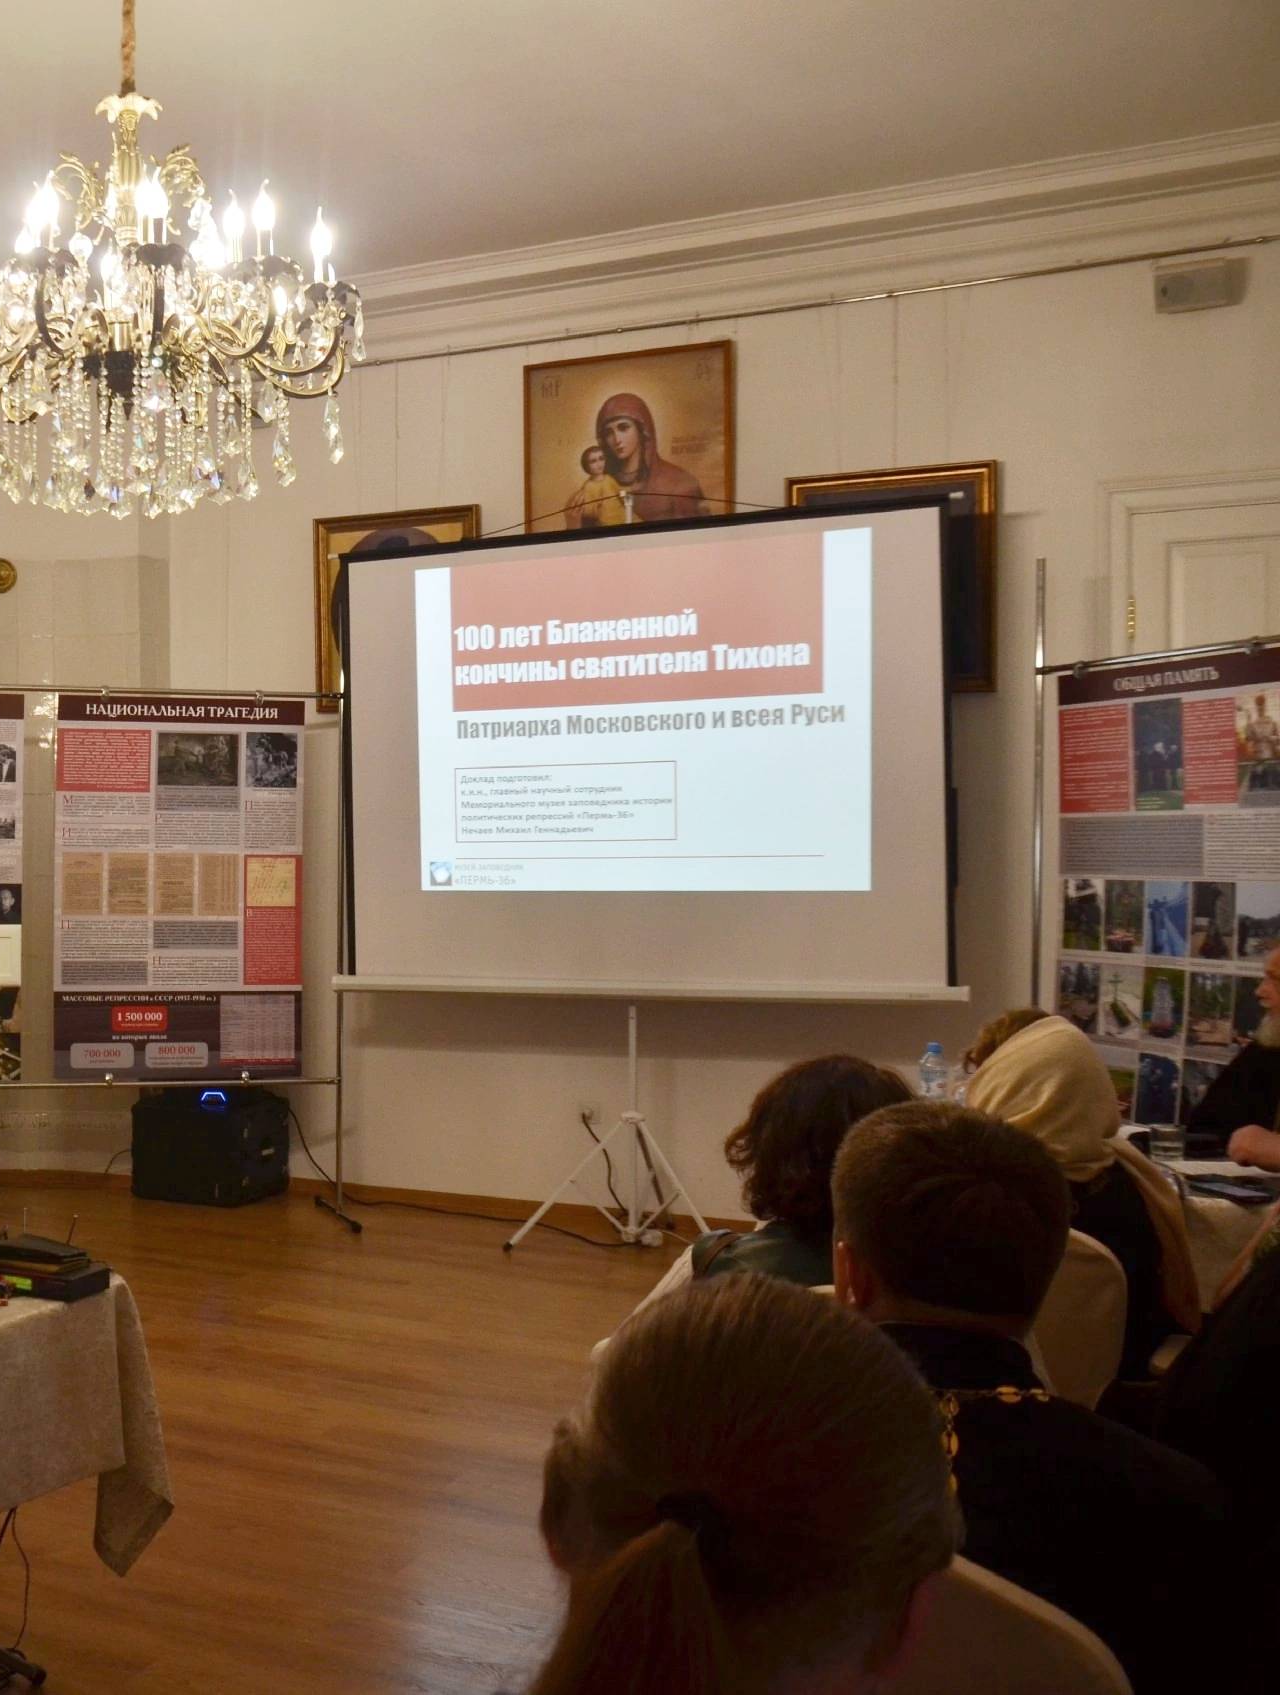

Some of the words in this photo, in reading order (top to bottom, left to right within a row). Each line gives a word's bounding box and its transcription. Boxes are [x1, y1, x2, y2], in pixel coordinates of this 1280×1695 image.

[454, 624, 495, 651] 100
[499, 625, 543, 648] лет
[547, 608, 698, 645] Блаженной
[455, 660, 567, 686] кончины
[571, 649, 708, 679] святителя
[711, 643, 811, 671] Тихона
[85, 703, 205, 719] НАЦИОНАЛЬНАЯ
[207, 705, 278, 720] ТРАГЕДИЯ
[456, 719, 561, 740] Патриарха
[566, 711, 706, 735] Московского
[712, 711, 725, 729] и
[732, 708, 784, 728] всея
[791, 703, 845, 726] Руси
[460, 775, 495, 784] Доклад
[117, 1012, 122, 1021] 1
[125, 1012, 143, 1021] 500
[144, 1012, 163, 1021] 000
